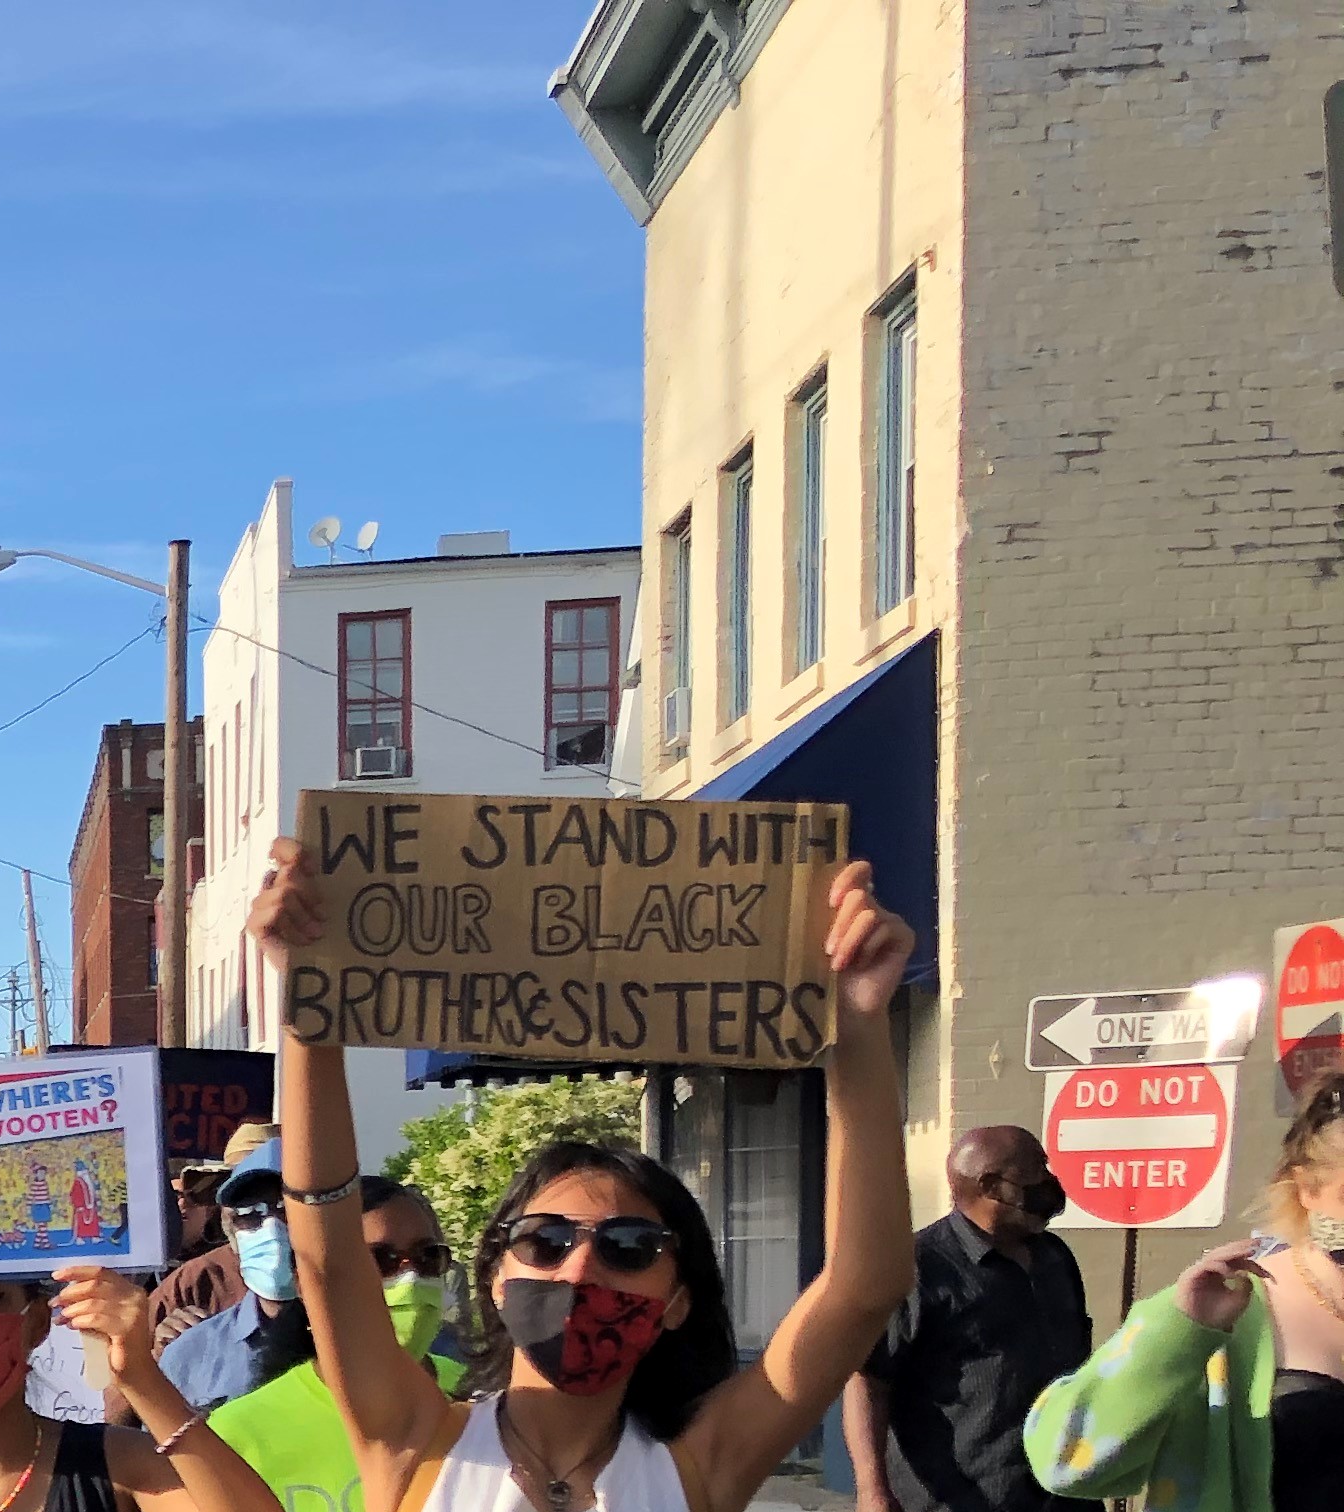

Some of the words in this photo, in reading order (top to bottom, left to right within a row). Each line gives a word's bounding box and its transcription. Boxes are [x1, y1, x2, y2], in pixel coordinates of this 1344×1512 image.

[320, 804, 421, 875] WE
[460, 804, 678, 870] STAND
[697, 811, 839, 869] WITH
[348, 882, 493, 957] OUR
[530, 881, 767, 956] BLACK
[1287, 965, 1310, 995] DO
[1097, 1015, 1155, 1044] ONE
[1171, 1014, 1208, 1040] WA
[1075, 1080, 1119, 1108] DO
[1140, 1075, 1206, 1106] NOT
[1083, 1160, 1188, 1189] ENTER
